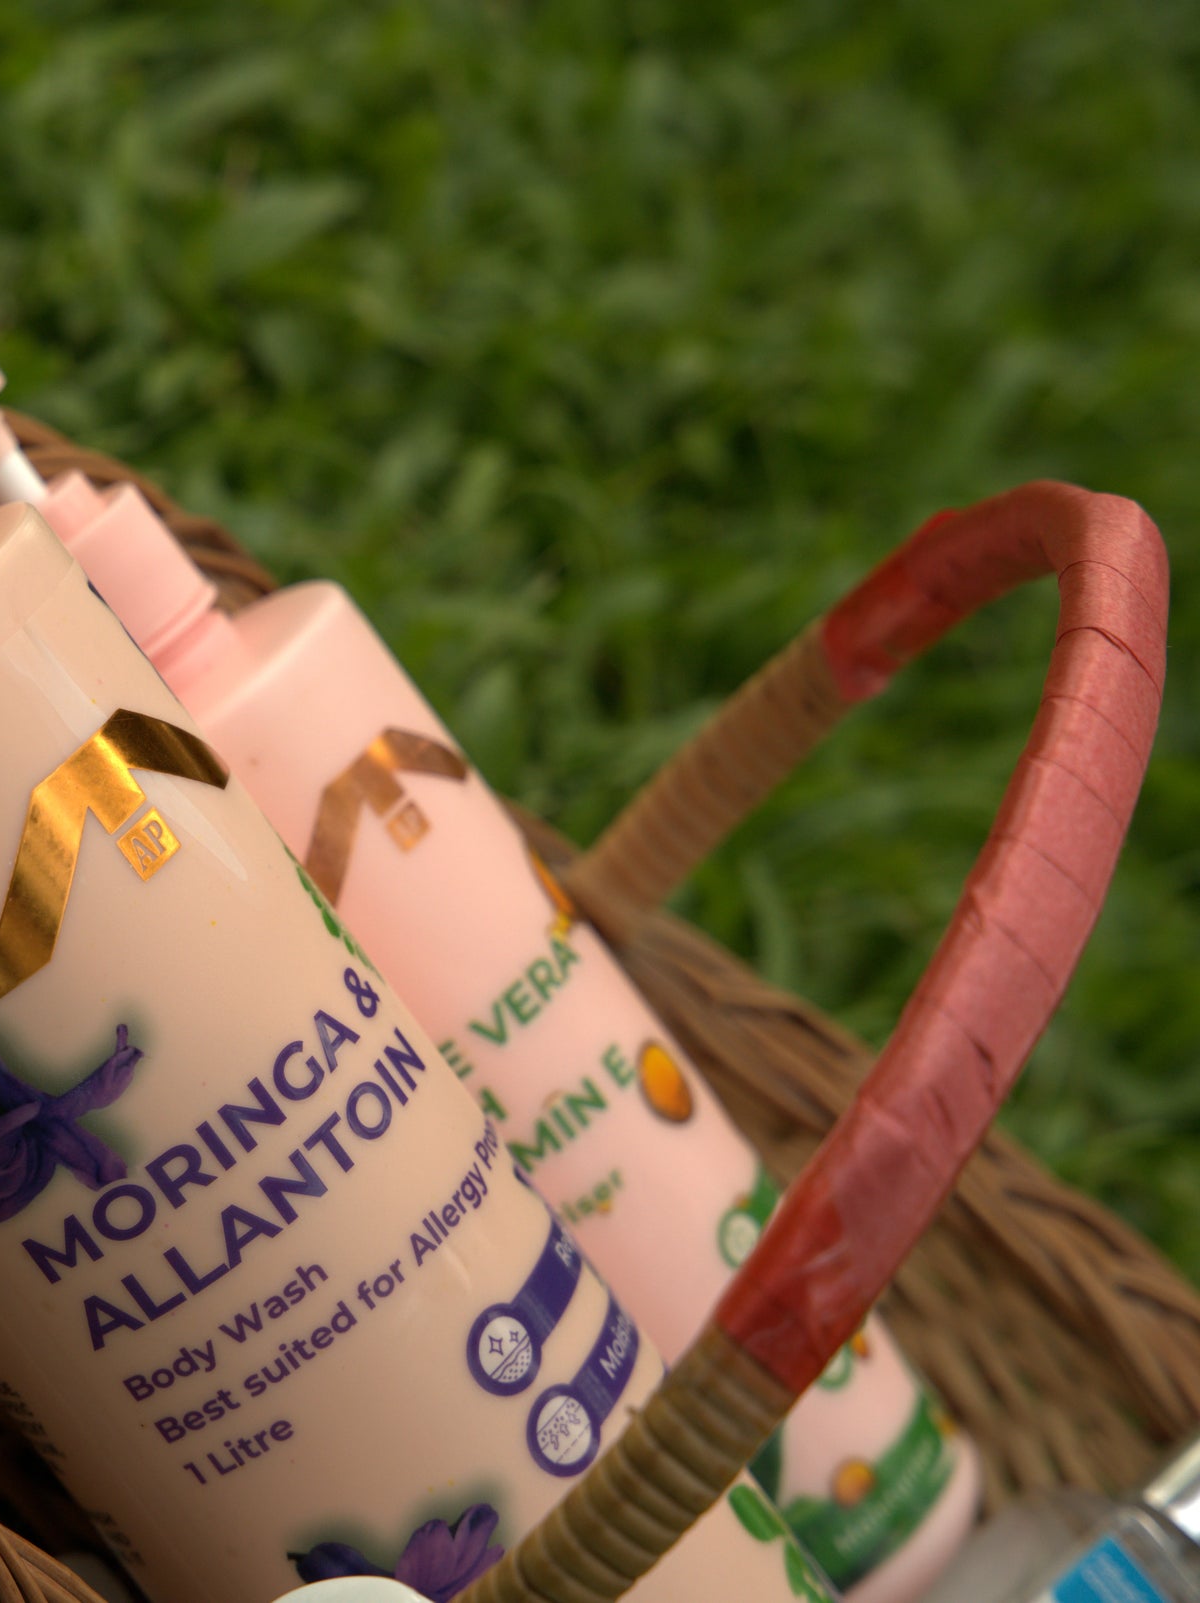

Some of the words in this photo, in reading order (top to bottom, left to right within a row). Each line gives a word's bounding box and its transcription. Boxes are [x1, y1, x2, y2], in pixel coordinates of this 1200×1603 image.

[130, 818, 168, 874] AP
[468, 938, 580, 1047] VERA
[21, 1009, 360, 1285] MORINGA
[343, 967, 381, 1019] &
[600, 1043, 637, 1089] E
[83, 1026, 427, 1352] ALLANTOIN
[122, 1339, 218, 1402] Body
[218, 1263, 330, 1345] Wash
[154, 1389, 241, 1445] Best
[242, 1299, 358, 1398] suited
[356, 1258, 406, 1310] for
[409, 1161, 489, 1268] Allergy
[182, 1460, 209, 1486] 1
[206, 1415, 296, 1476] Litre
